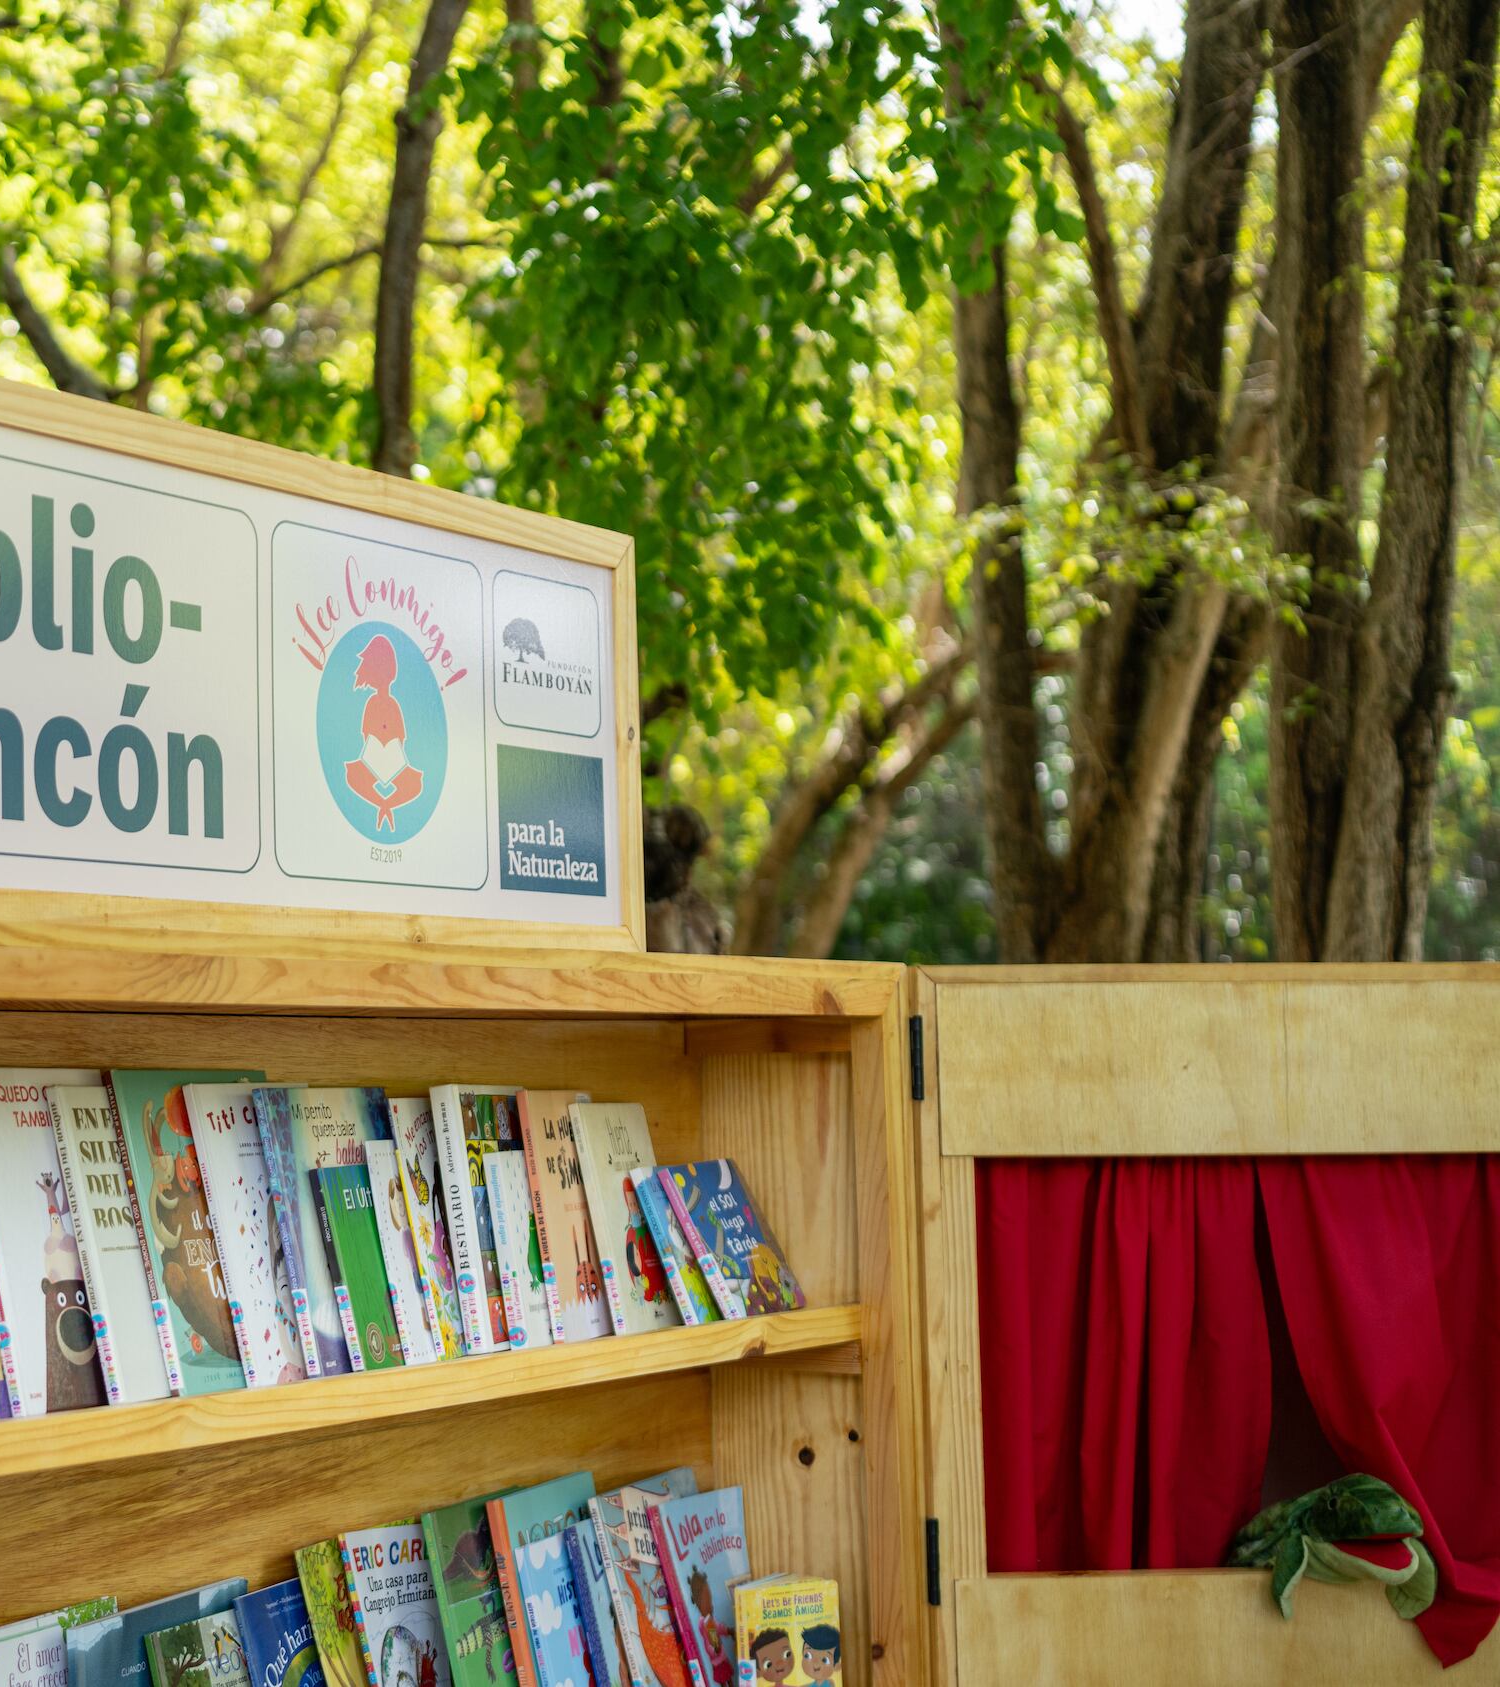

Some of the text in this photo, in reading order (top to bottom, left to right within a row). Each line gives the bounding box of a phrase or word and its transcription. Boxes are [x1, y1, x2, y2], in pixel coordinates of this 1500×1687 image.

[345, 555, 467, 691] Conmigo!
[503, 662, 592, 695] FLAMBOYÁN
[547, 660, 592, 674] FUNDACIÓN
[507, 820, 565, 848] para la
[508, 850, 598, 882] Naturaleza
[12, 1111, 53, 1128] TAMBI
[72, 1108, 99, 1131] EN
[206, 1106, 235, 1134] Titi
[291, 1102, 333, 1121] Mi perrito
[312, 1121, 357, 1142] quiere bailar
[404, 1110, 432, 1146] Me encan
[543, 1117, 556, 1140] LA
[79, 1140, 122, 1164] SILE
[335, 1138, 366, 1165] ballet
[415, 1136, 427, 1161] los
[546, 1156, 556, 1174] DE
[87, 1174, 122, 1198] DEL
[343, 1184, 373, 1210] El Últ
[440, 1102, 471, 1271] BESTIARIO Adrienne Barman
[709, 1196, 721, 1212] el
[93, 1207, 135, 1229] BOS
[538, 1215, 543, 1226] DE
[720, 1214, 745, 1233] llega
[540, 1227, 549, 1255] HUERTA
[726, 1233, 759, 1255] tarde
[667, 1508, 726, 1562] Lola en la
[352, 1543, 384, 1572] ERIC
[700, 1535, 742, 1565] biblioteca
[367, 1575, 384, 1592] Una
[385, 1576, 404, 1589] casa
[406, 1571, 429, 1590] para
[363, 1584, 438, 1614] Cangrejo Ermitañ
[17, 1642, 62, 1674] El amor
[121, 1660, 147, 1677] CUANDO
